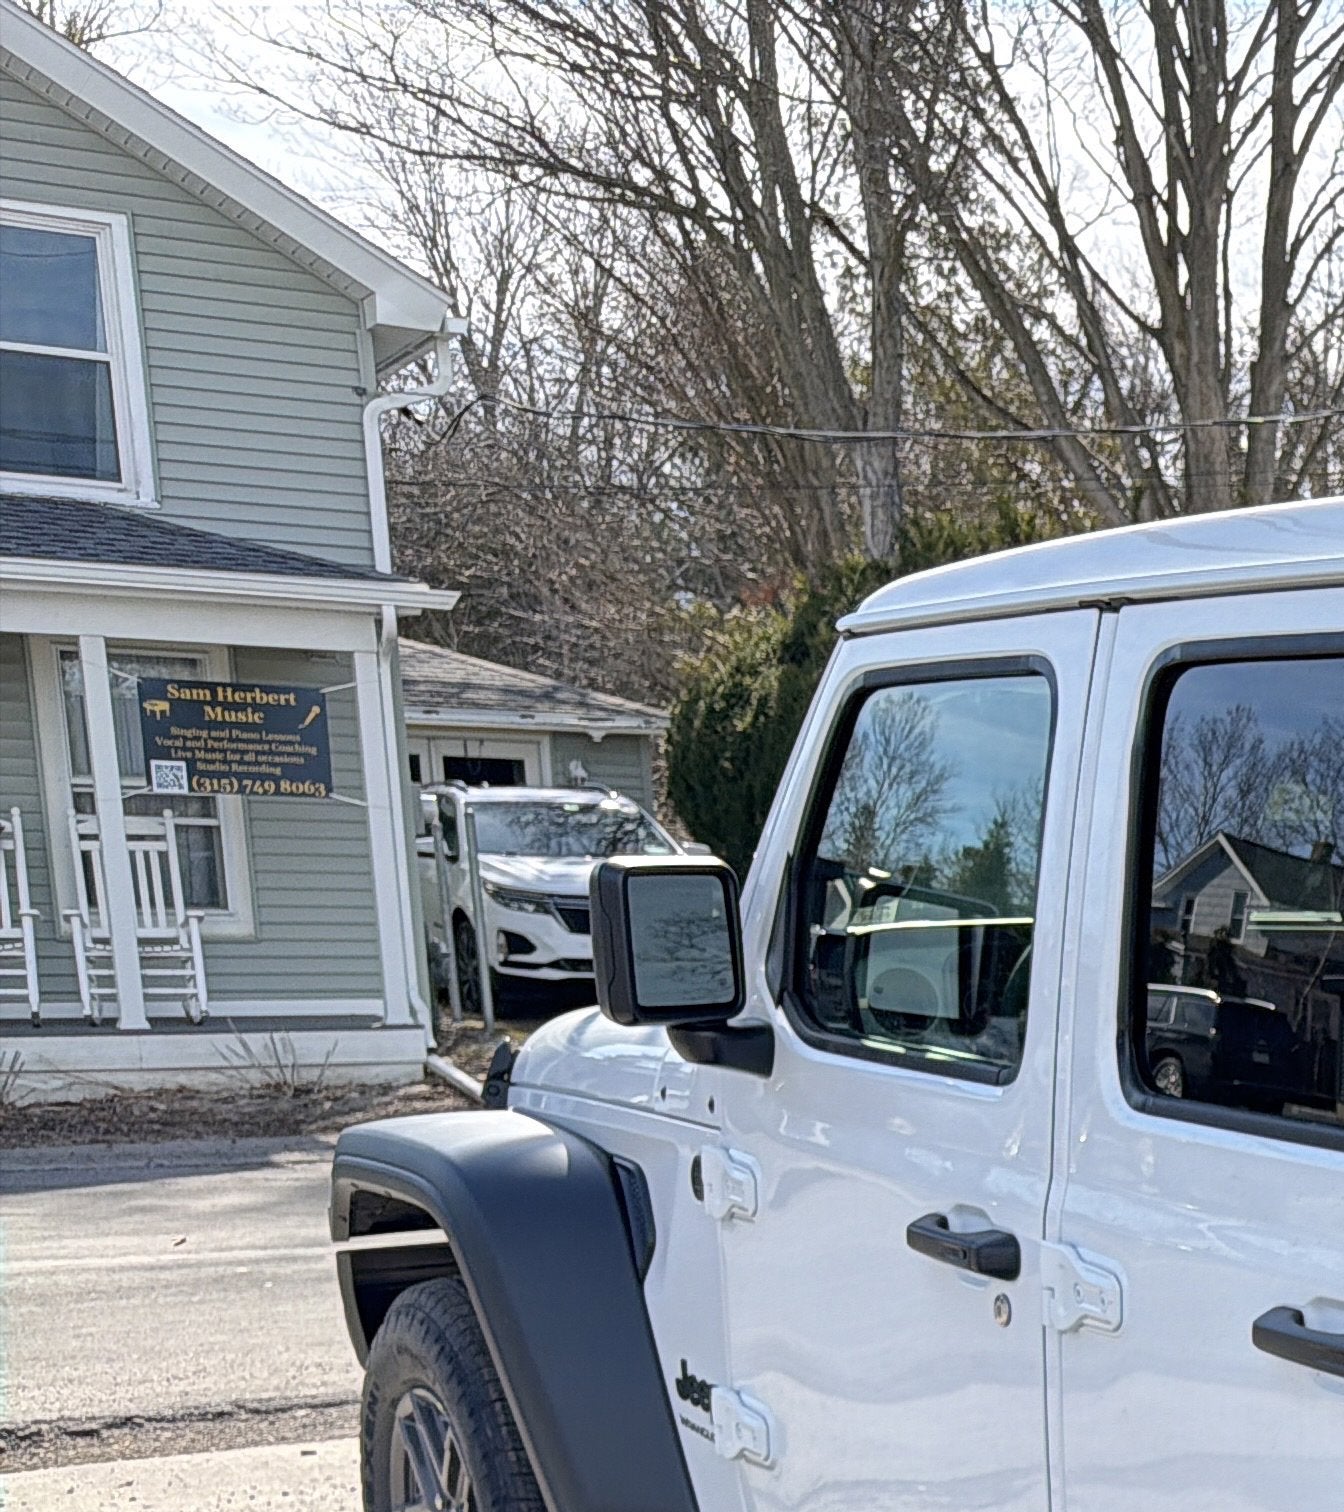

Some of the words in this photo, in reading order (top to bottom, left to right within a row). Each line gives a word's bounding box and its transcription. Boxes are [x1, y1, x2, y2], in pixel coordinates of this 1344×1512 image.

[167, 683, 212, 701] Sam
[217, 687, 297, 706] Herbert
[204, 705, 265, 724] Music
[170, 726, 208, 738] Singing
[210, 728, 230, 738] and
[232, 729, 260, 740] Piano
[262, 731, 301, 741] Lessons
[155, 736, 184, 747] Vocal
[186, 738, 205, 748] and
[207, 740, 270, 752] Performance
[271, 743, 317, 755] Coaching
[171, 750, 193, 759] Live
[195, 751, 225, 761] Music
[226, 751, 241, 762] for
[196, 761, 230, 772] Studio
[232, 763, 281, 775] Recording
[191, 777, 239, 794] (315)
[242, 779, 276, 795] 749
[280, 780, 326, 797] 8063
[675, 1358, 714, 1420] Jee
